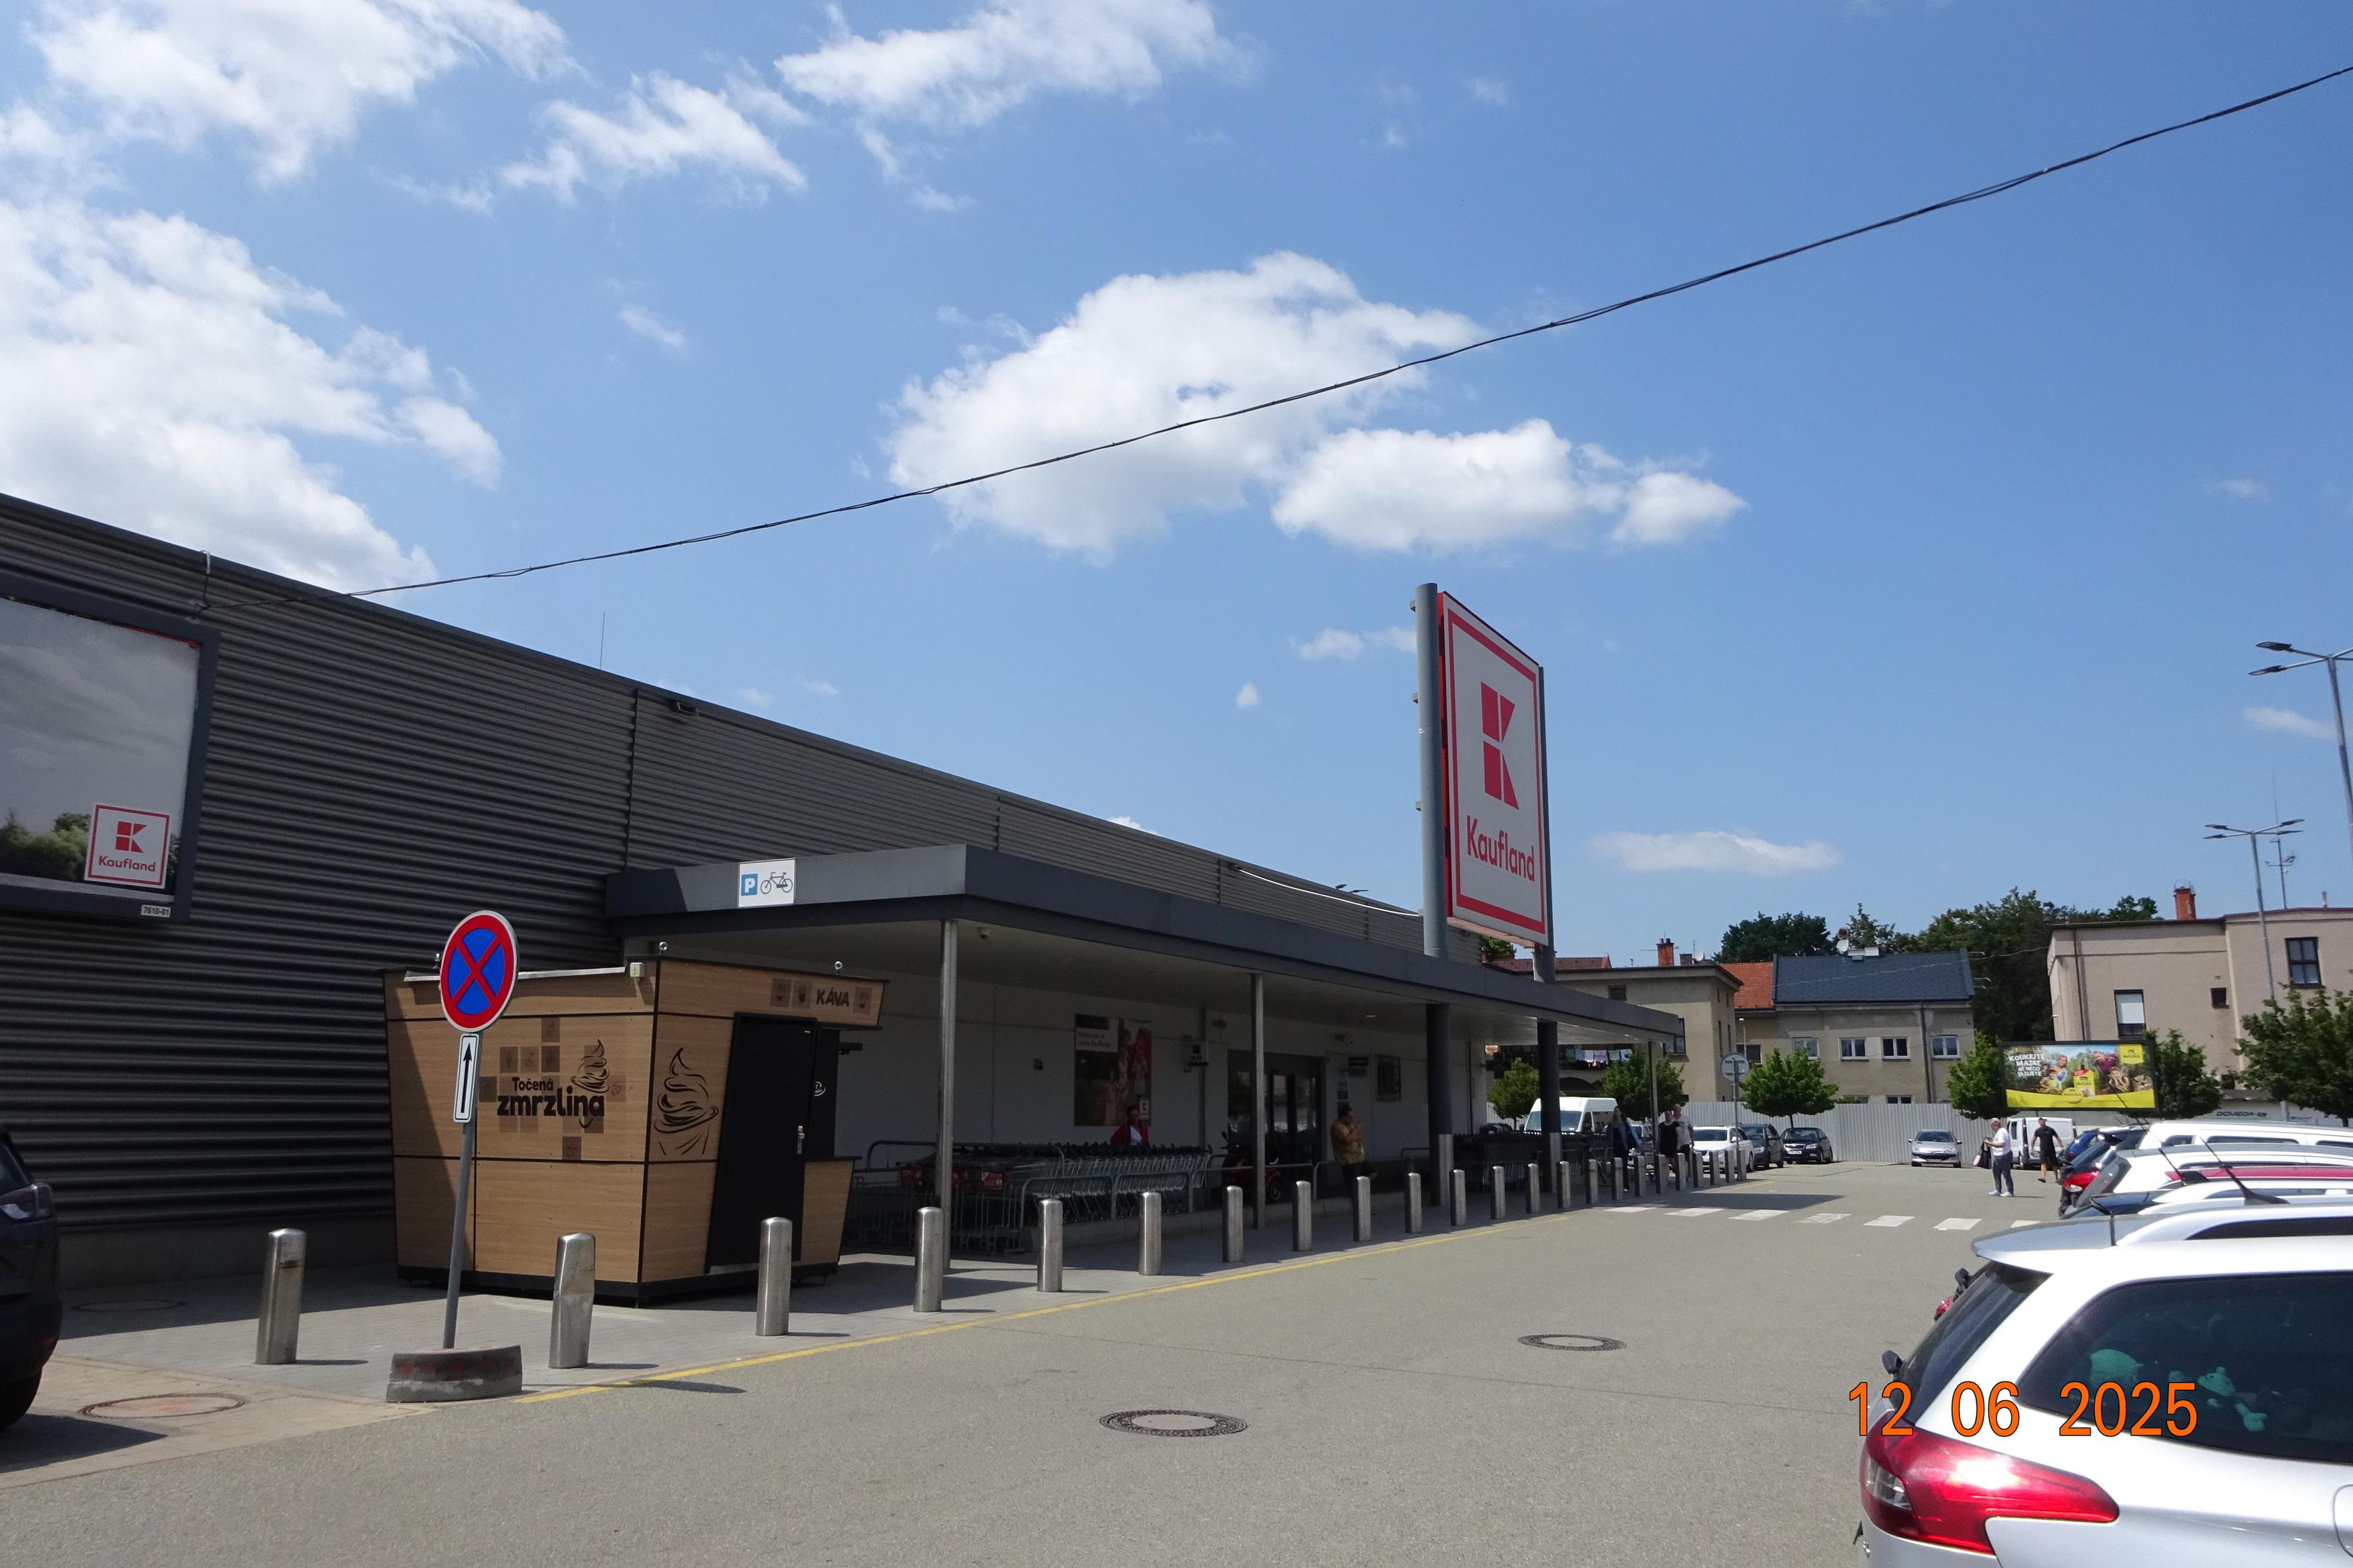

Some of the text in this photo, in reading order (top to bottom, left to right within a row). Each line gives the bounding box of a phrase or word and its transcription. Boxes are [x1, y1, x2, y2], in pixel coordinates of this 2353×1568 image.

[1467, 815, 1534, 882] Kaufland
[98, 856, 156, 872] Kaufland
[745, 878, 756, 893] P
[816, 987, 849, 1007] KÁVA
[2008, 1053, 2045, 1062] KOUKEJTE
[512, 1077, 554, 1092] Točená
[497, 1086, 605, 1116] zmrzlina
